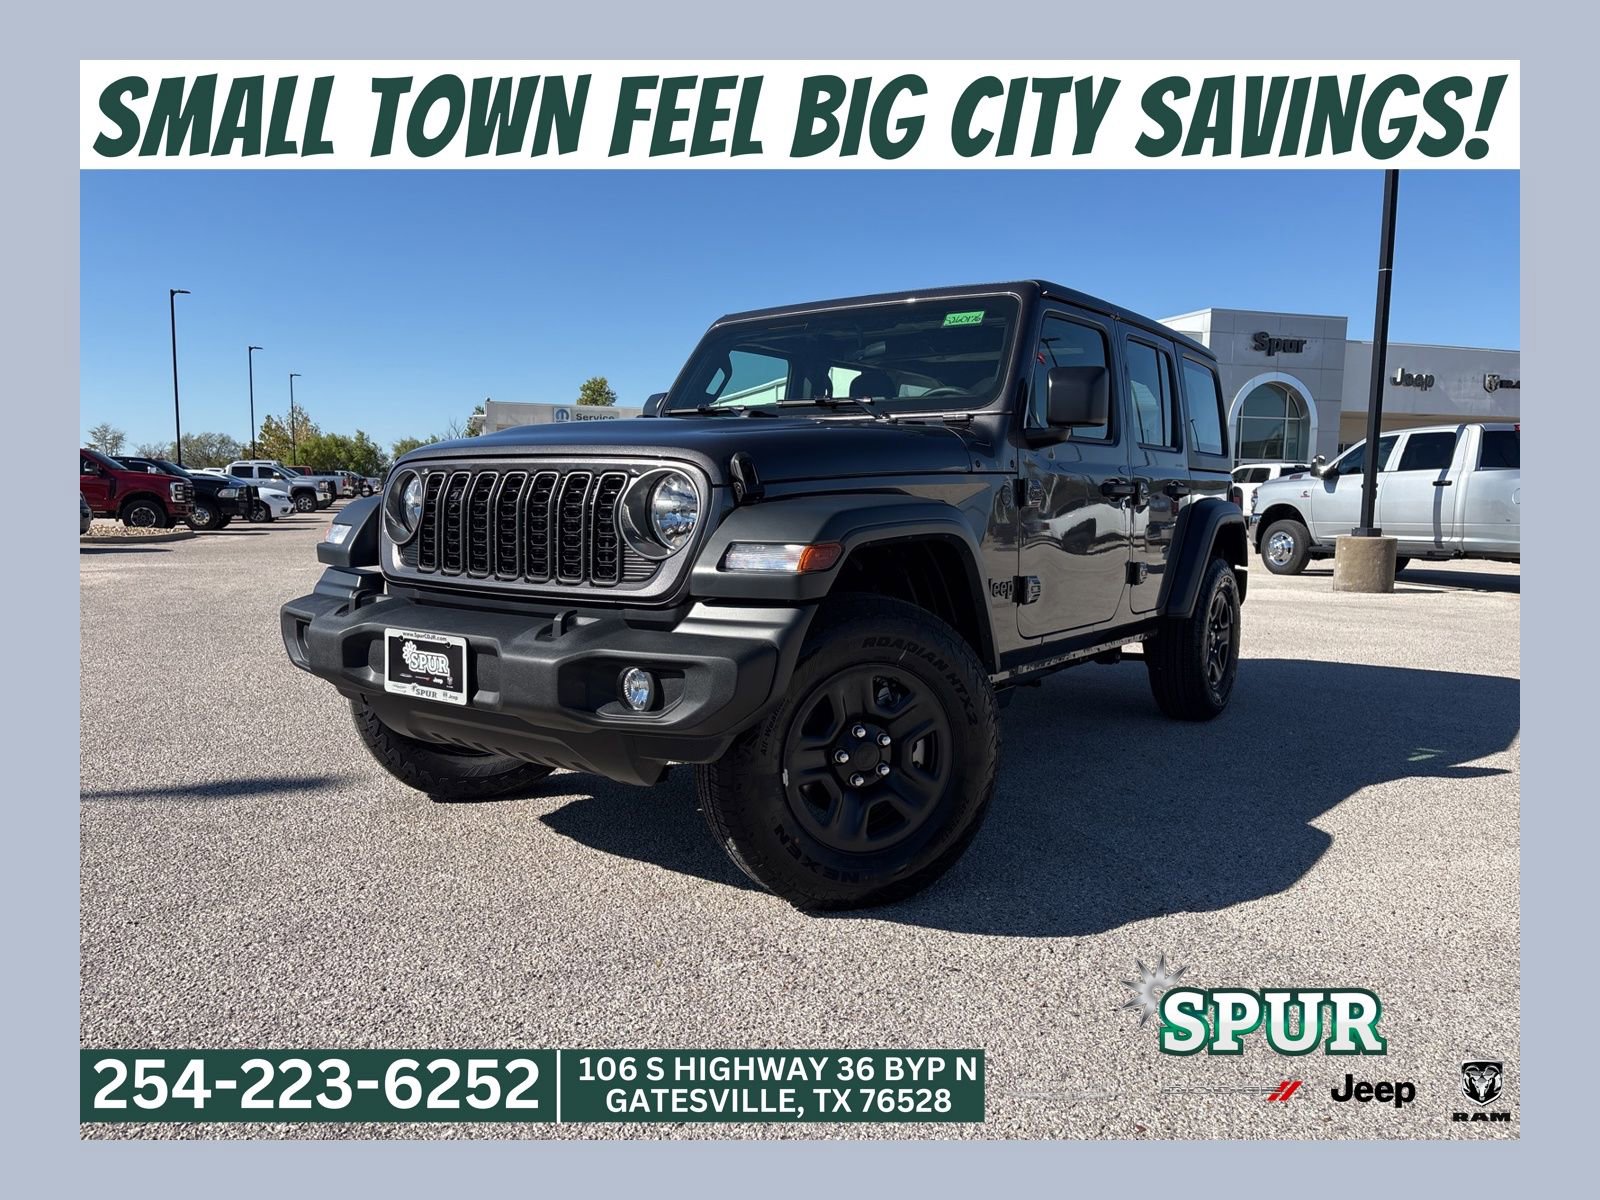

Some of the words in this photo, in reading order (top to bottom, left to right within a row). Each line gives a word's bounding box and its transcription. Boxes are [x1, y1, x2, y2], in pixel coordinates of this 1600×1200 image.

[1253, 331, 1307, 356] Spur
[1391, 368, 1434, 391] Jeep
[409, 651, 449, 675] SPUR
[861, 636, 949, 673] ROADIAN
[416, 688, 437, 698] SPUR
[774, 823, 861, 884] NEXEN
